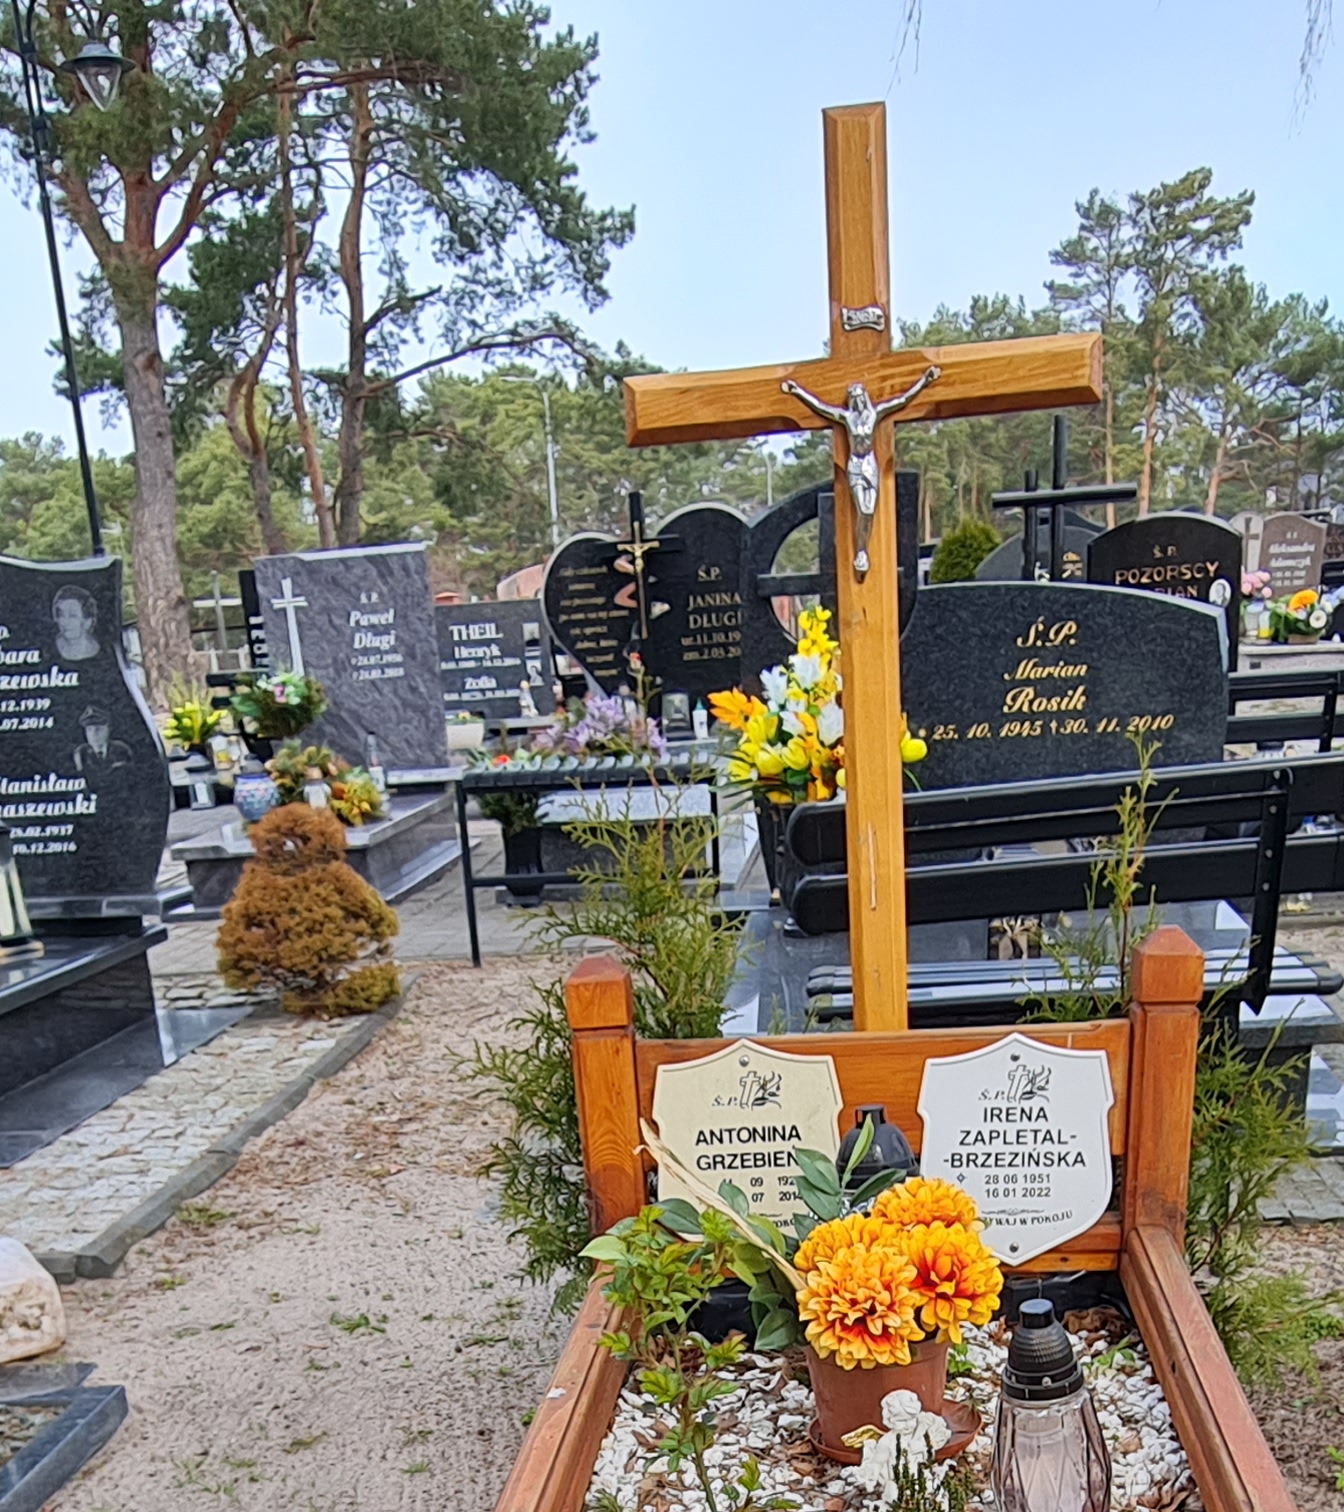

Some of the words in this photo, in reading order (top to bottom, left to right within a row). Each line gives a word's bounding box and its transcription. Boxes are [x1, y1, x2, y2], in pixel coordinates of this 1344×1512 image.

[1115, 561, 1219, 585] POZORSCY
[687, 591, 743, 612] JANINA
[448, 622, 504, 640] THEIL
[1003, 658, 1088, 681] Marian
[1002, 685, 1088, 714] Rosik
[983, 1106, 1049, 1123] IRENA
[695, 1125, 802, 1146] ANTONINA
[959, 1128, 1077, 1146] ZAPLETAL-
[943, 1147, 1086, 1169] -BRZEZIŃSKA
[749, 1176, 764, 1187] 09
[1022, 1173, 1051, 1184] 1951
[751, 1192, 765, 1203] 07
[1003, 1187, 1017, 1198] 01
[1021, 1186, 1051, 1198] 2022
[1019, 1216, 1029, 1226] W
[1031, 1209, 1073, 1226] POKOJU
